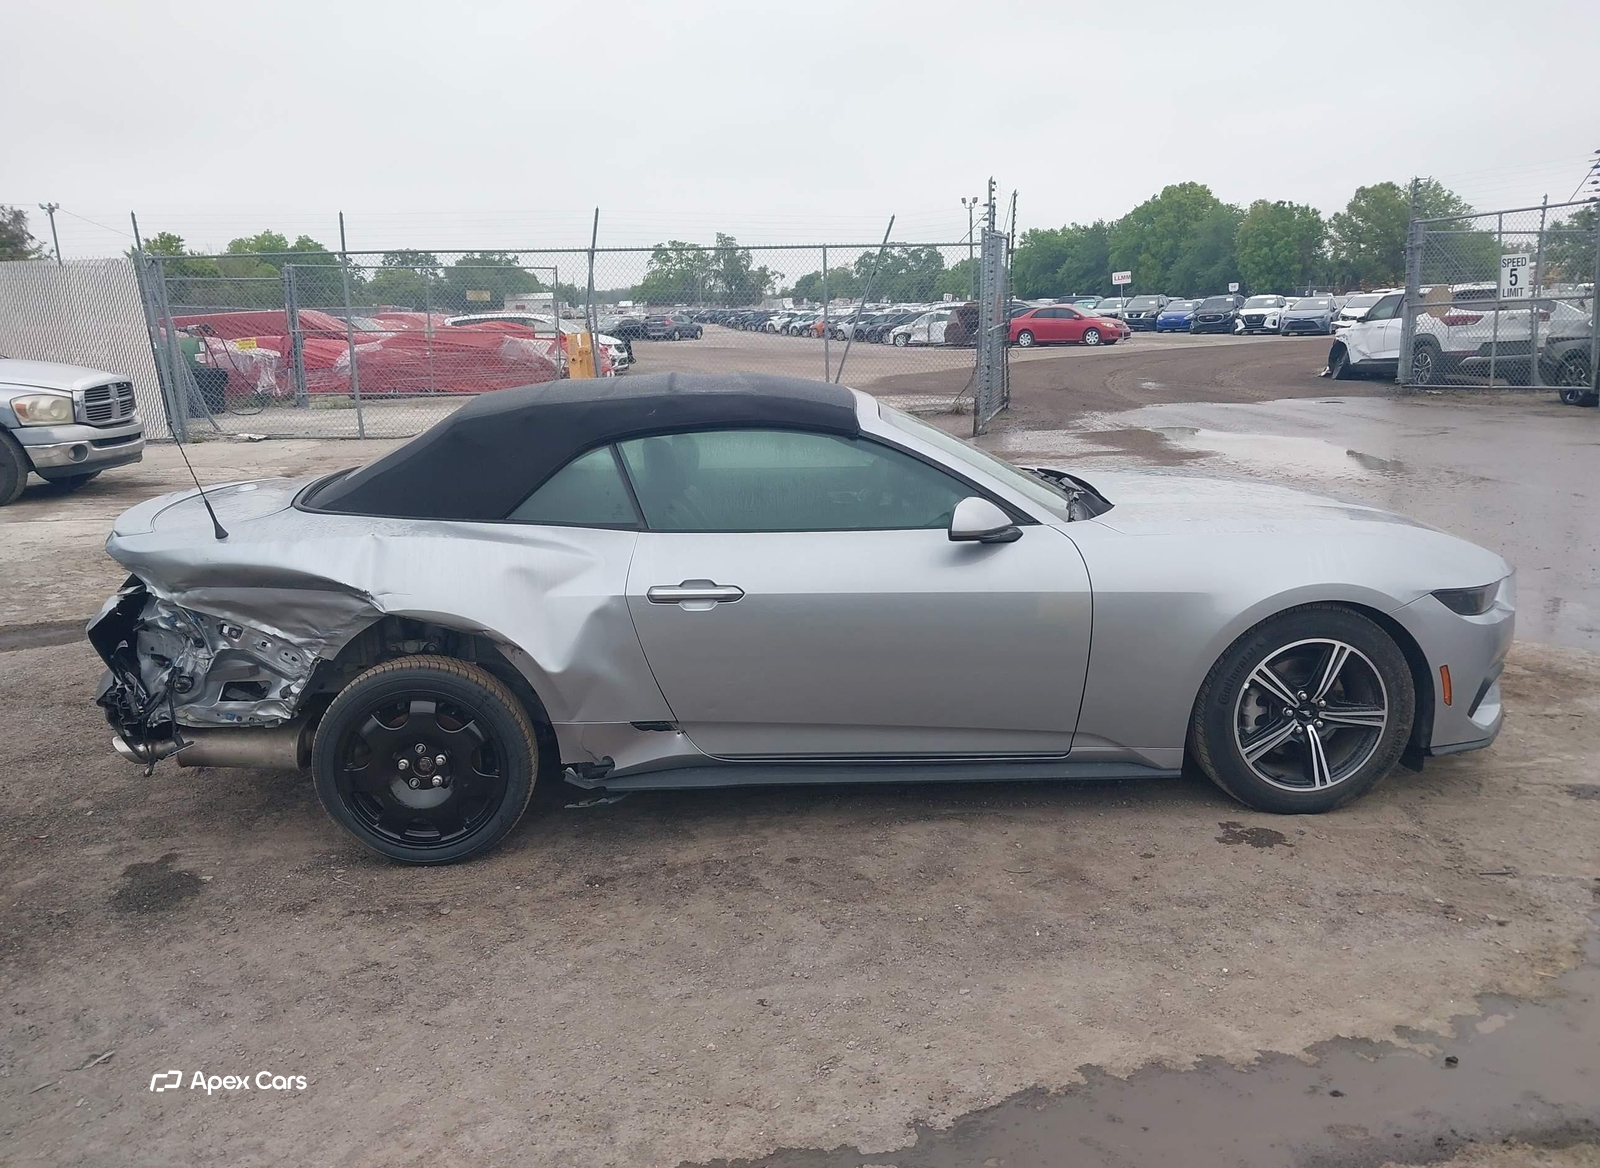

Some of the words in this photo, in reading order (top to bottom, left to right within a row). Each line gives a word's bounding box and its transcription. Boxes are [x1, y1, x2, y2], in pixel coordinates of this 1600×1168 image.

[1502, 257, 1527, 268] SPEED
[1509, 268, 1518, 286] 5
[1502, 287, 1525, 298] LIMIT
[1218, 647, 1257, 705] Continental
